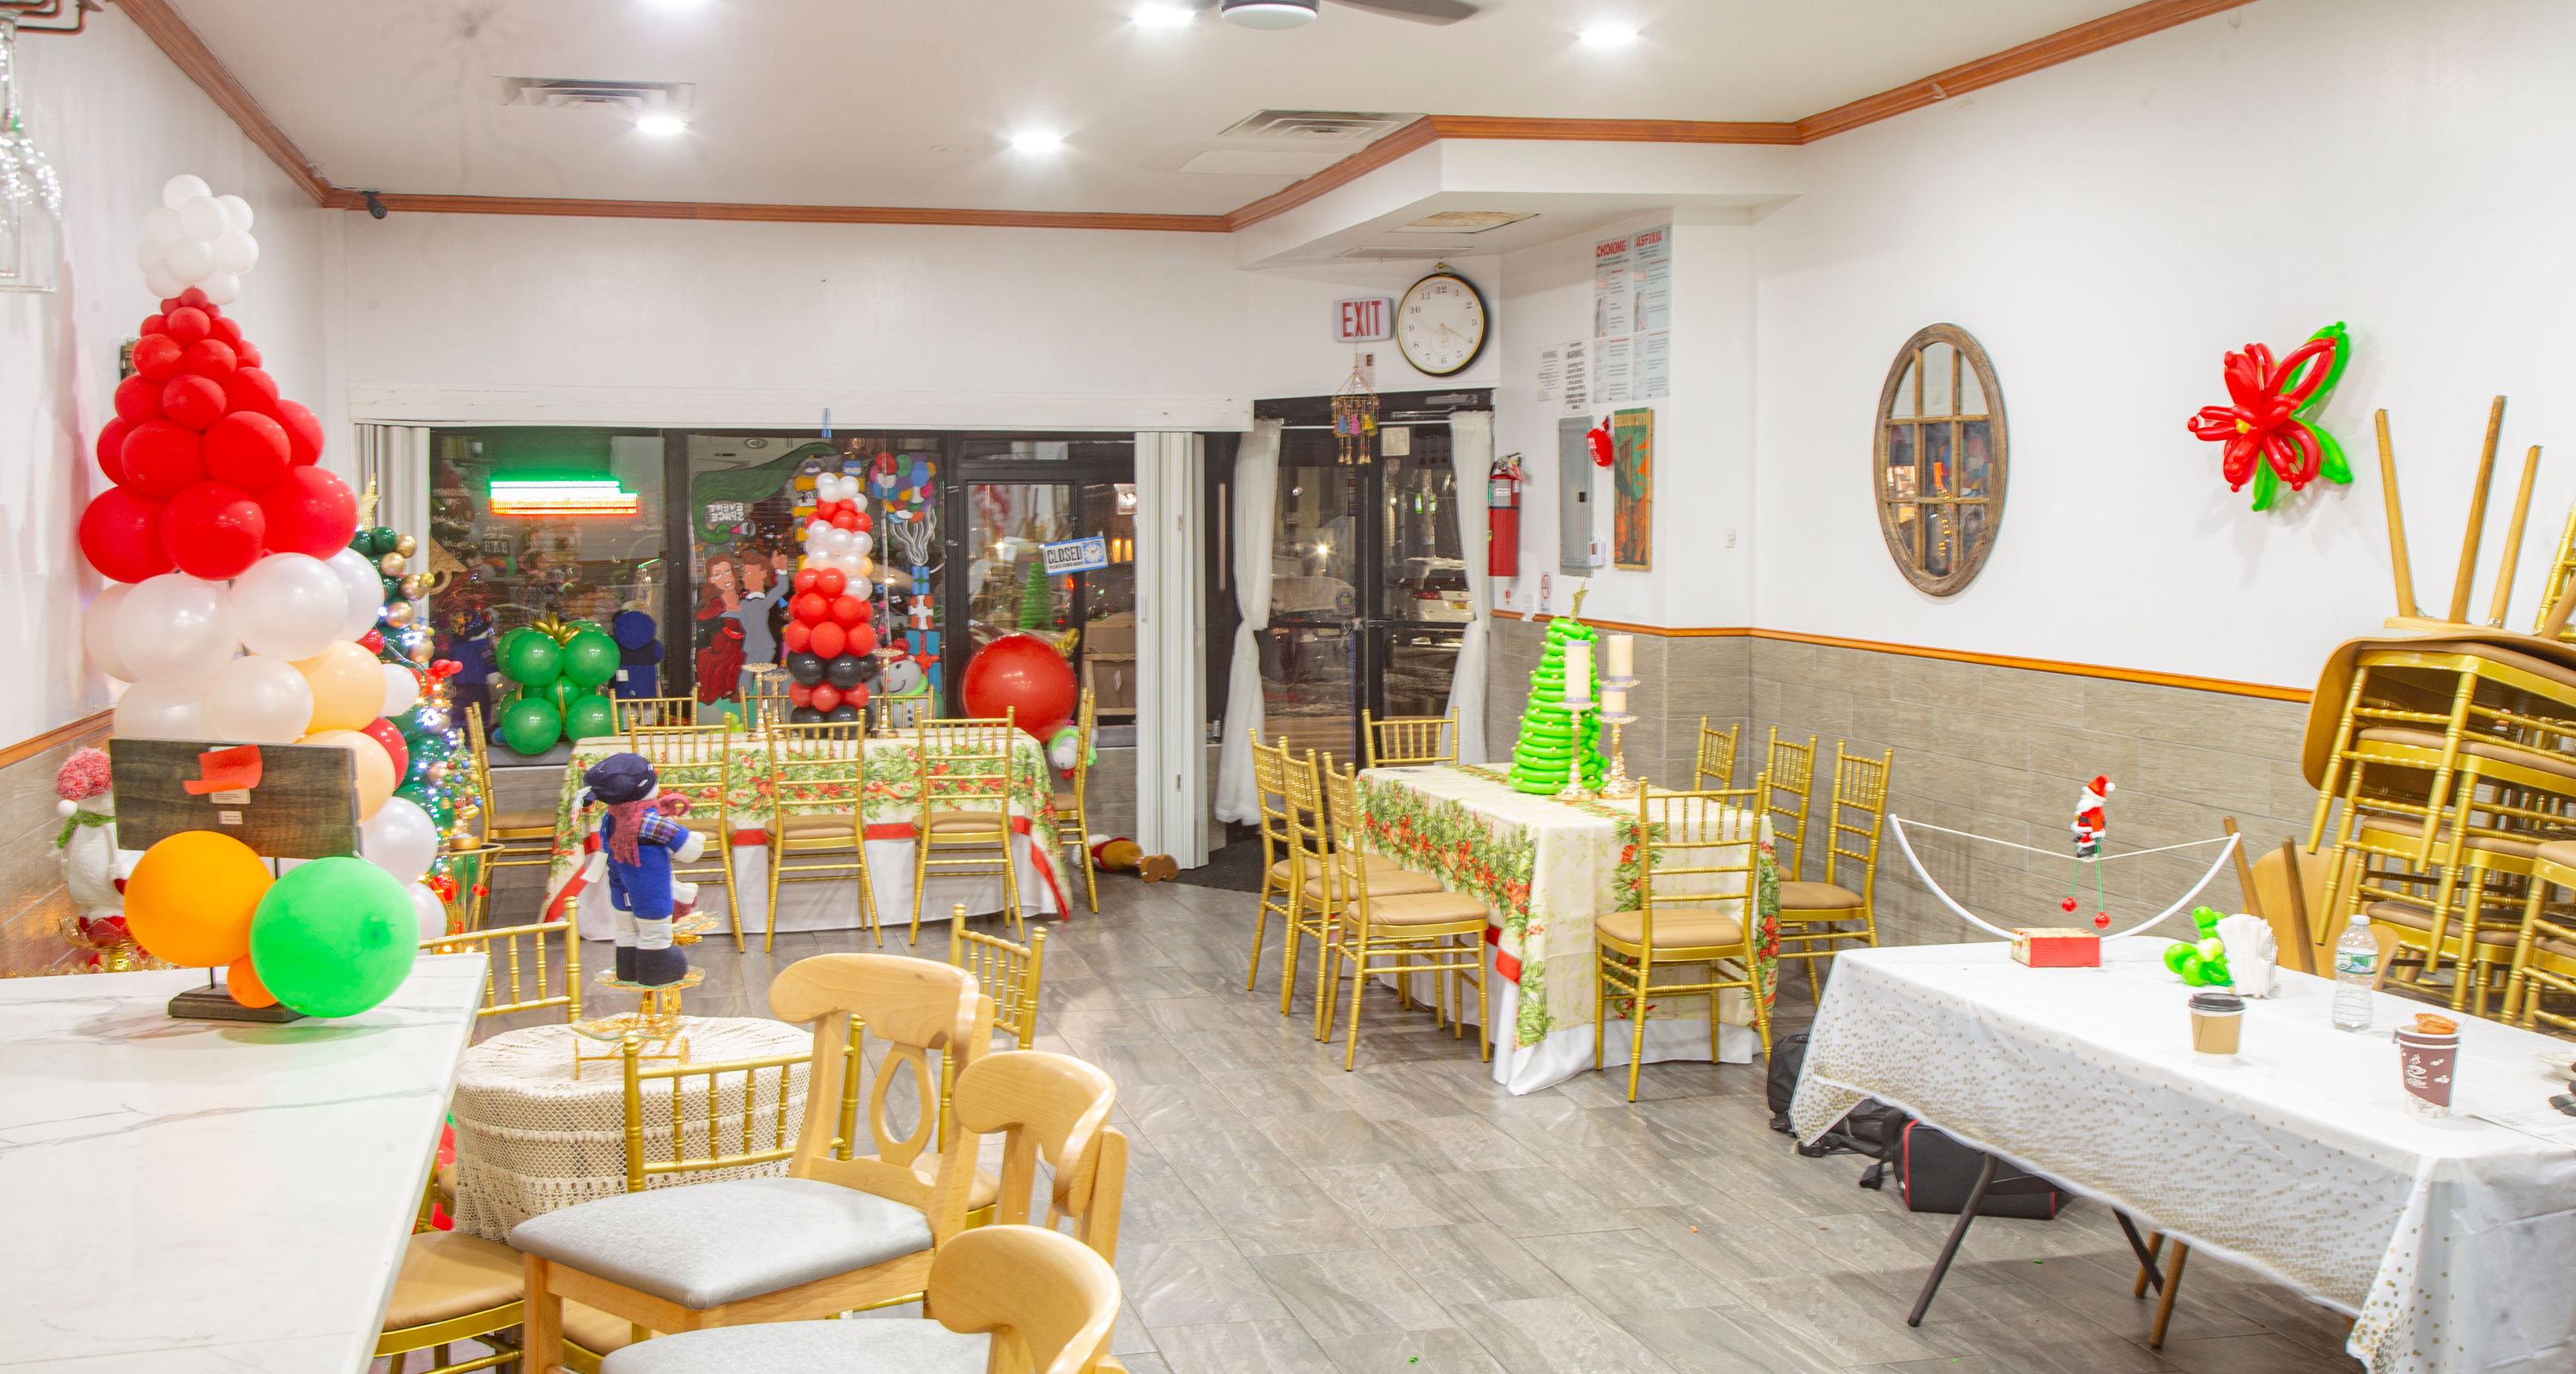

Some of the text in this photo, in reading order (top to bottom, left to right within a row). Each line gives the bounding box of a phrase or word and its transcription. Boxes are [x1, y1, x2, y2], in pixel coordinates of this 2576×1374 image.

[1636, 230, 1662, 248] ASFIXIA
[1596, 240, 1626, 258] CHOKING
[1421, 292, 1431, 301] 11
[1342, 301, 1382, 337] EXIT
[1409, 306, 1421, 314] 10
[1047, 545, 1082, 563] CLOSED
